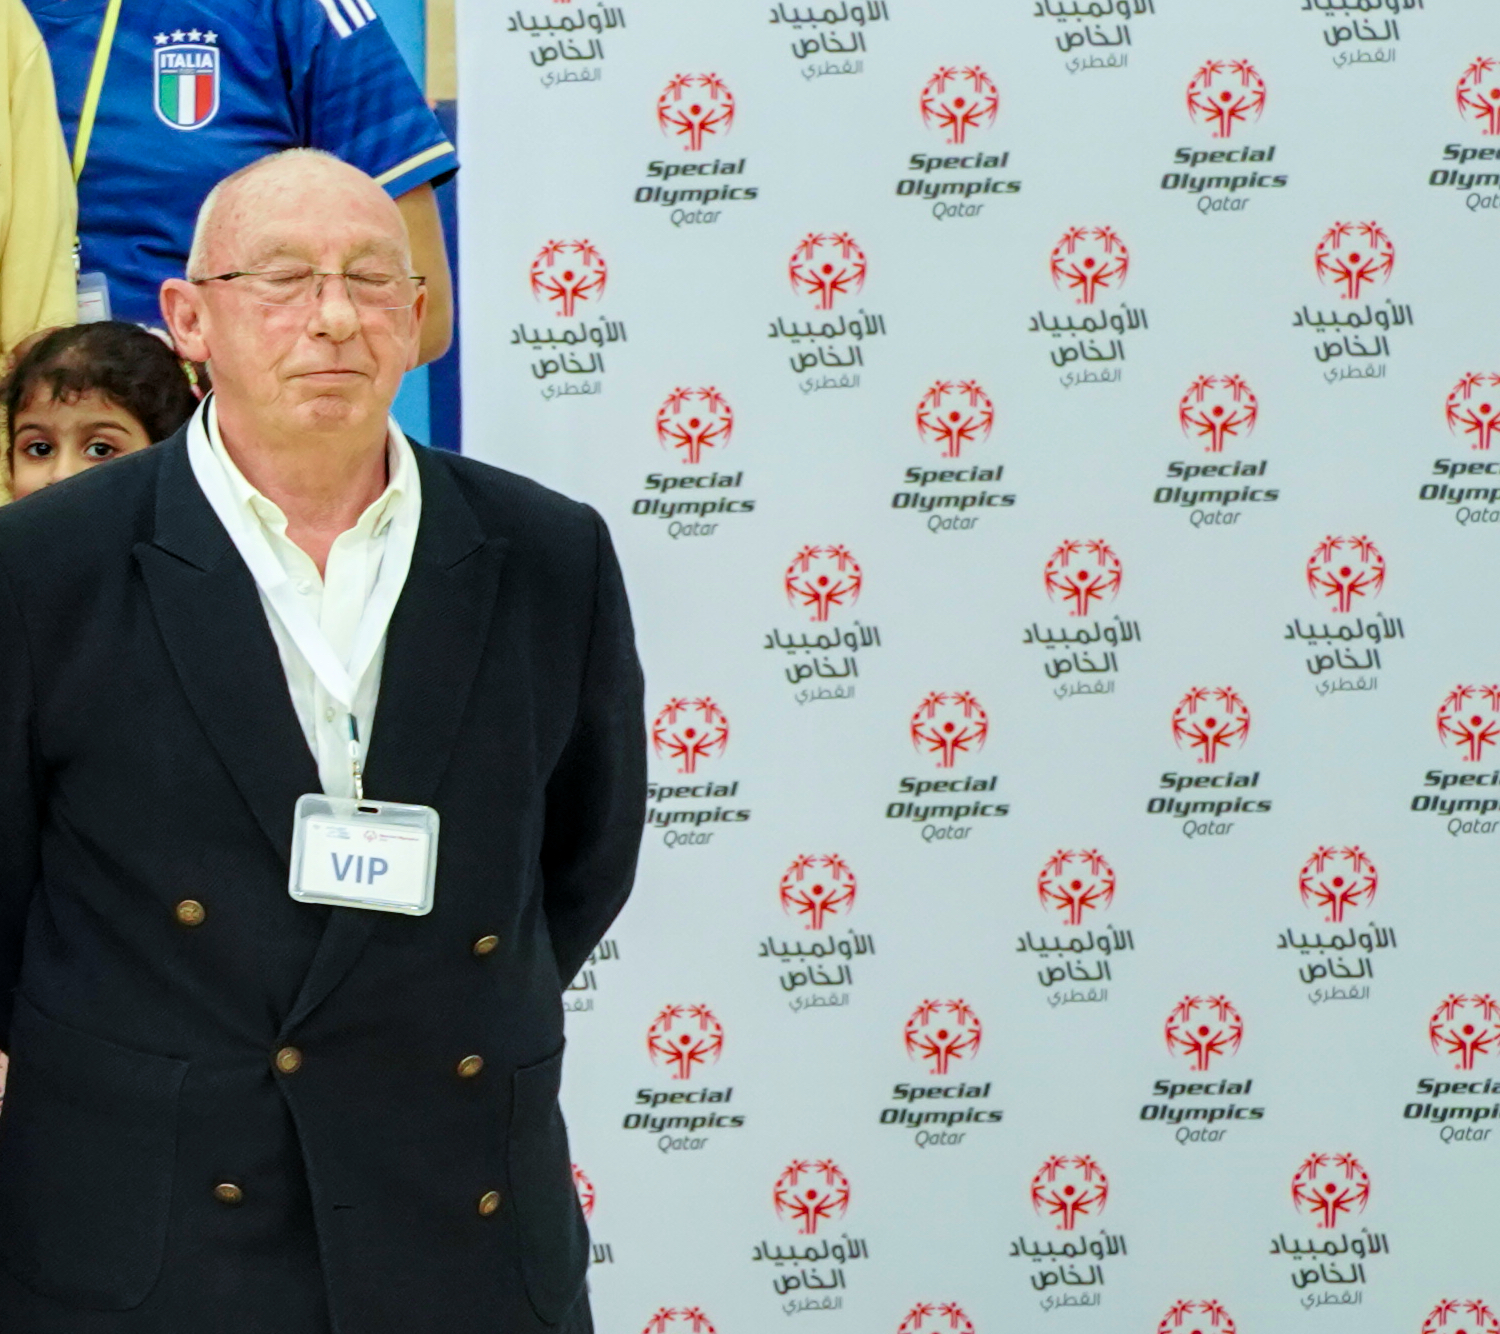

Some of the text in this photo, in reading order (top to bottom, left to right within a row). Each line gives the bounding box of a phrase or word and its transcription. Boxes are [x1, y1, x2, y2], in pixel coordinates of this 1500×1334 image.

[507, 2, 626, 37] الأولمبياد
[1056, 24, 1131, 52] الخاص
[1323, 19, 1400, 47] الخاص
[530, 39, 604, 67] الخاص
[792, 31, 866, 59] الخاص
[160, 53, 214, 68] ITALIA
[1174, 145, 1276, 168] Special
[647, 158, 746, 181] Special
[1161, 171, 1288, 193] Olympics
[634, 184, 758, 206] Olympics
[1196, 195, 1250, 216] Qatar
[670, 208, 722, 228] Qatar
[511, 316, 627, 350] الأولمبياد
[531, 352, 605, 380] الخاص
[904, 465, 1004, 487] Special
[891, 491, 1016, 513] Olympics
[927, 514, 979, 534] Qatar
[1023, 615, 1141, 649] الأولمبياد
[1044, 651, 1118, 679] الخاص
[1160, 771, 1260, 793] Special
[1146, 797, 1272, 818] Olympics
[1182, 819, 1235, 840] Qatar
[330, 851, 389, 885] VIP
[1277, 922, 1397, 955] الأولمبياد
[1299, 957, 1373, 984] الخاص
[636, 1087, 733, 1108] Special
[622, 1112, 745, 1133] Olympics
[657, 1134, 709, 1154] Qatar
[752, 1233, 869, 1266] الأولمبياد
[773, 1268, 846, 1295] الخاص
